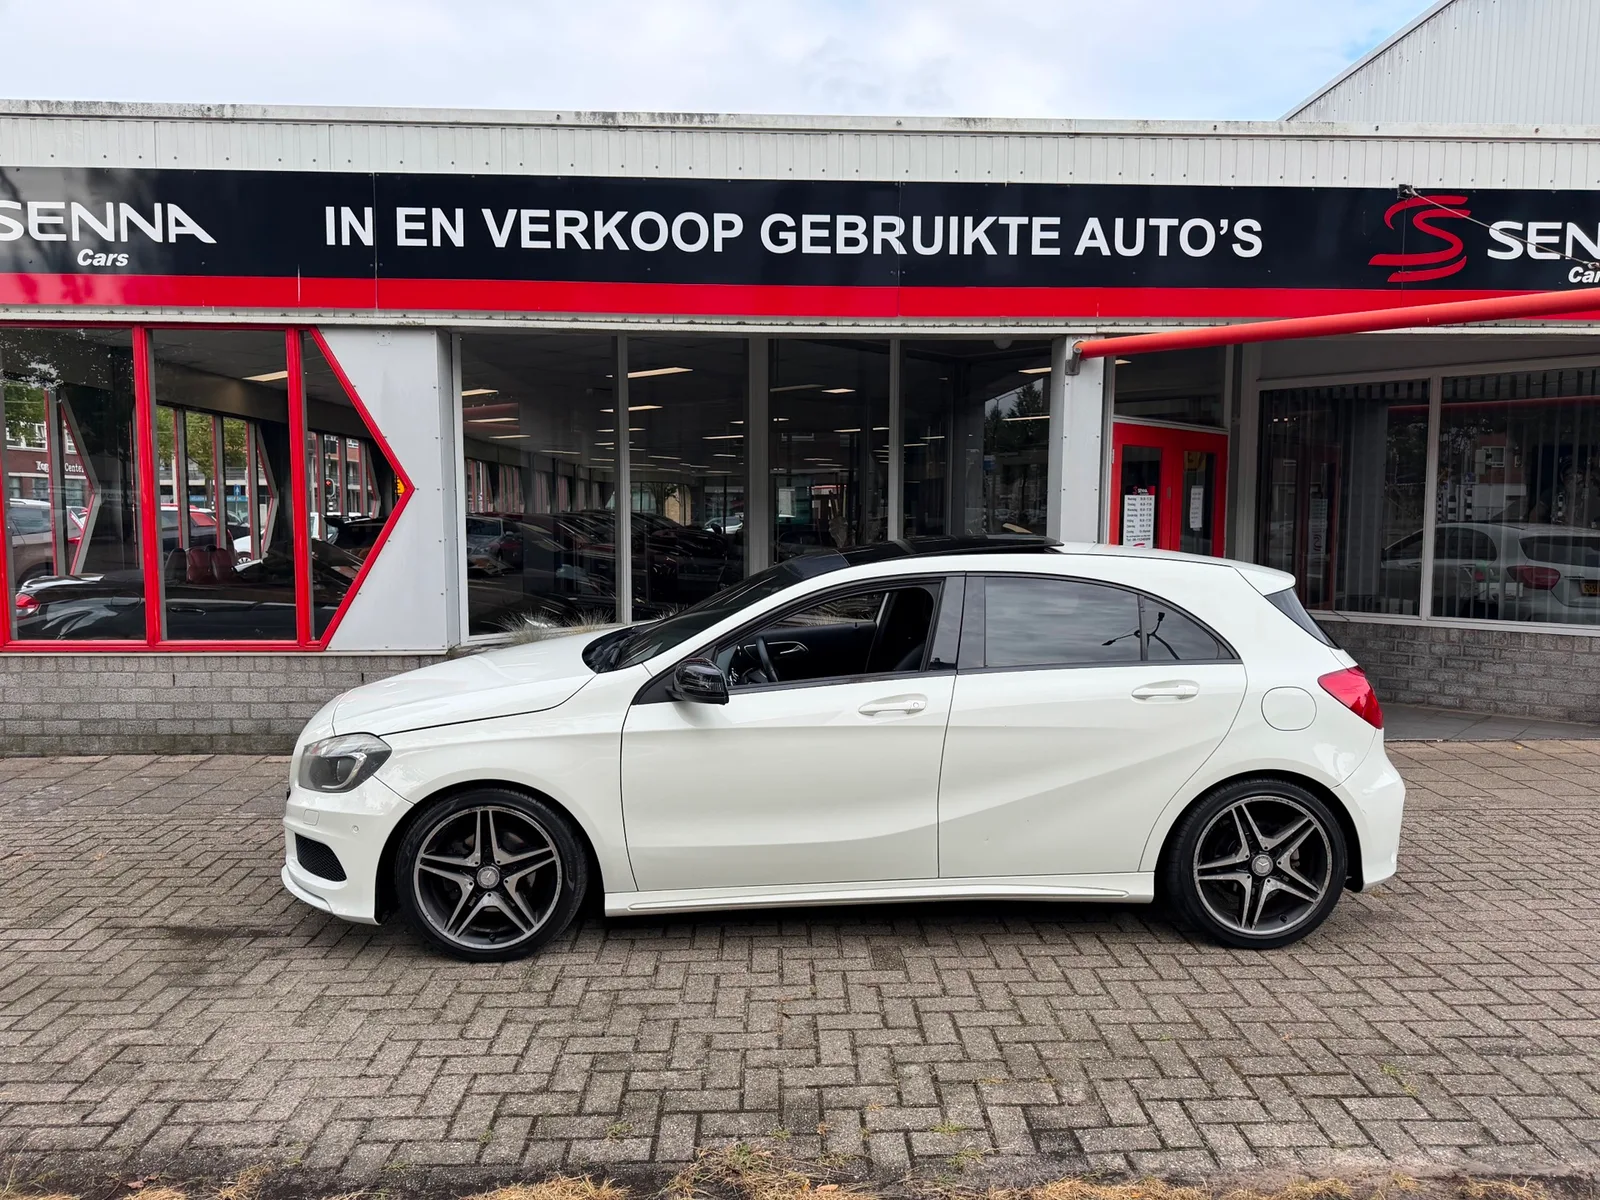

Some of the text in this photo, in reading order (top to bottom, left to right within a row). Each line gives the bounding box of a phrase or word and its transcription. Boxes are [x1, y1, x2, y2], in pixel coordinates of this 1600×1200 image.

[0, 200, 217, 244] SENNA
[325, 206, 1263, 258] IN EN VERKOOP GEBRUIKTE AUTO’S
[77, 248, 129, 267] Cars
